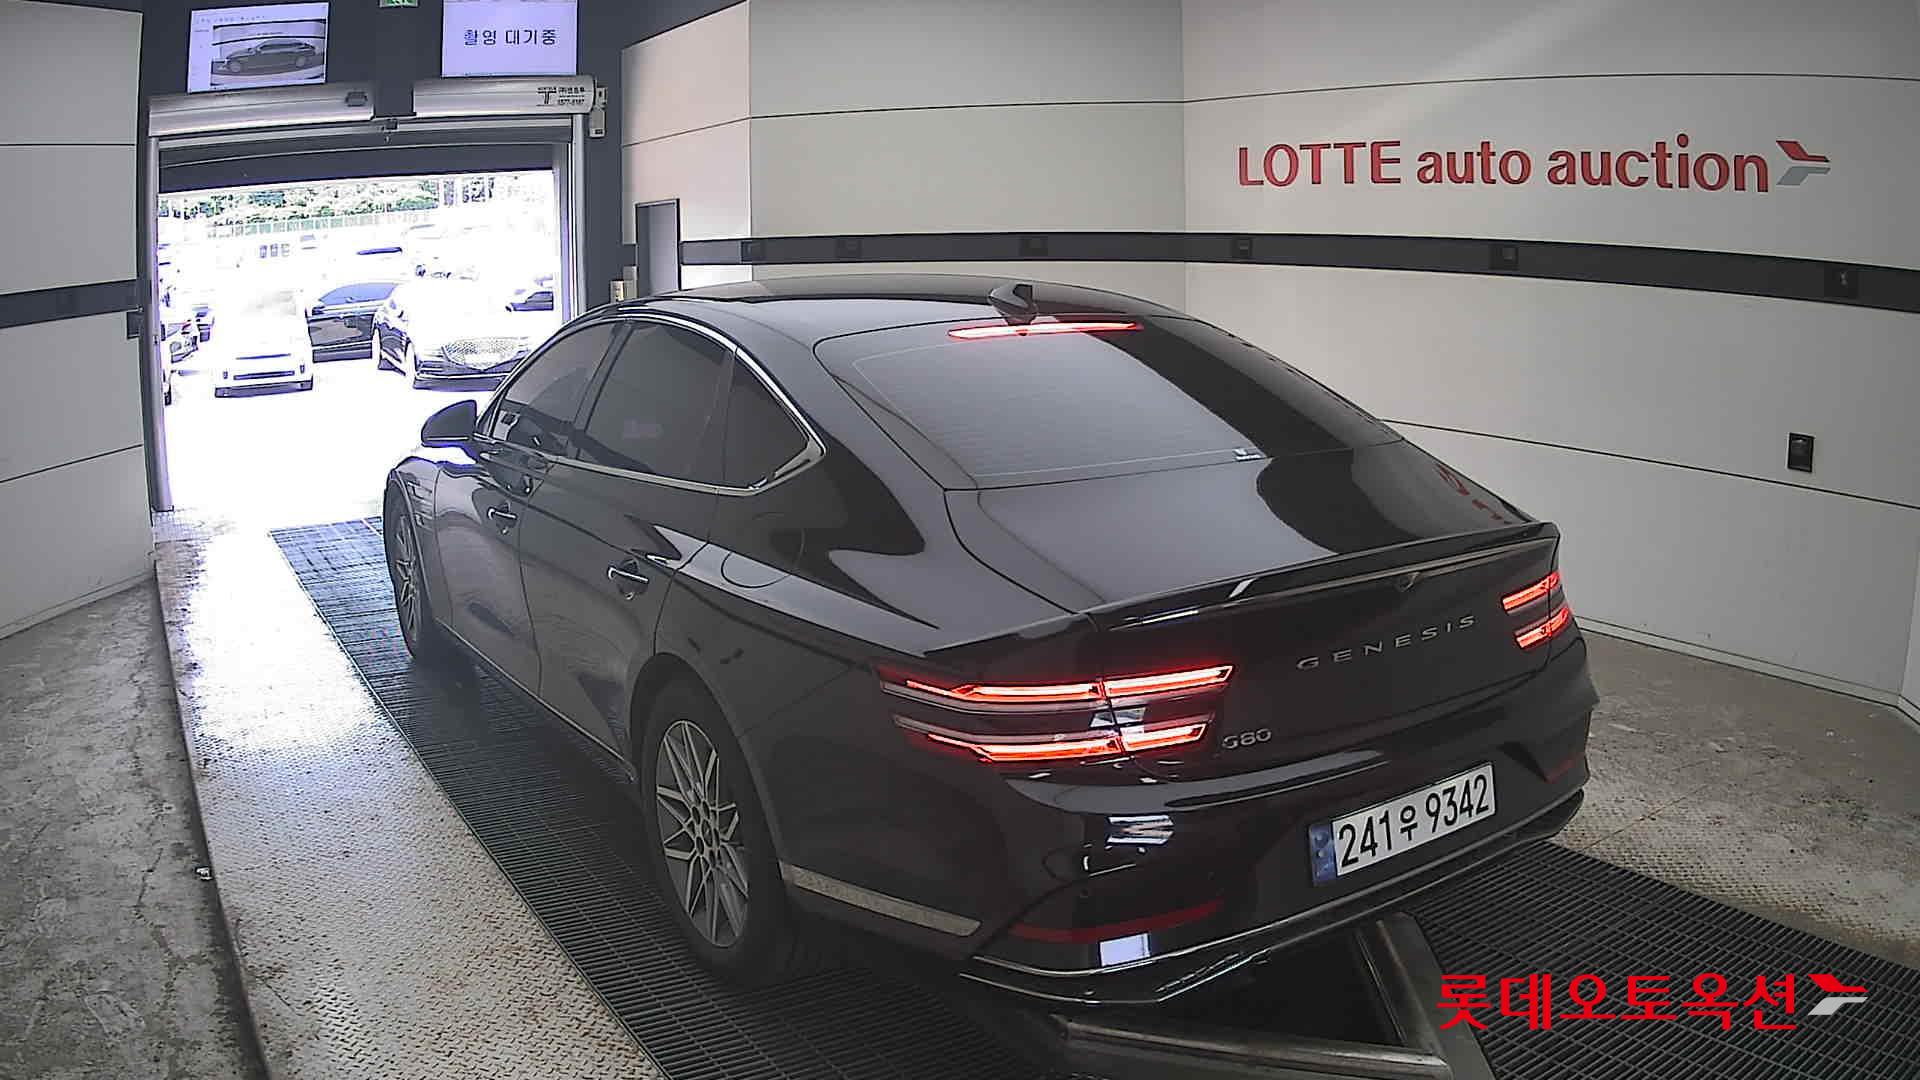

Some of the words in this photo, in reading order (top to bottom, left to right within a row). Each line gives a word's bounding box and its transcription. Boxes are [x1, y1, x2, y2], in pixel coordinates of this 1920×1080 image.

[505, 29, 557, 46] 대기중
[1238, 140, 1401, 187] LOTTE
[1417, 141, 1532, 184] auto
[1547, 134, 1769, 192] auction
[1296, 614, 1476, 670] GENESIS
[1222, 728, 1273, 750] G80
[1338, 805, 1418, 868] 241우
[1425, 773, 1490, 834] 9342
